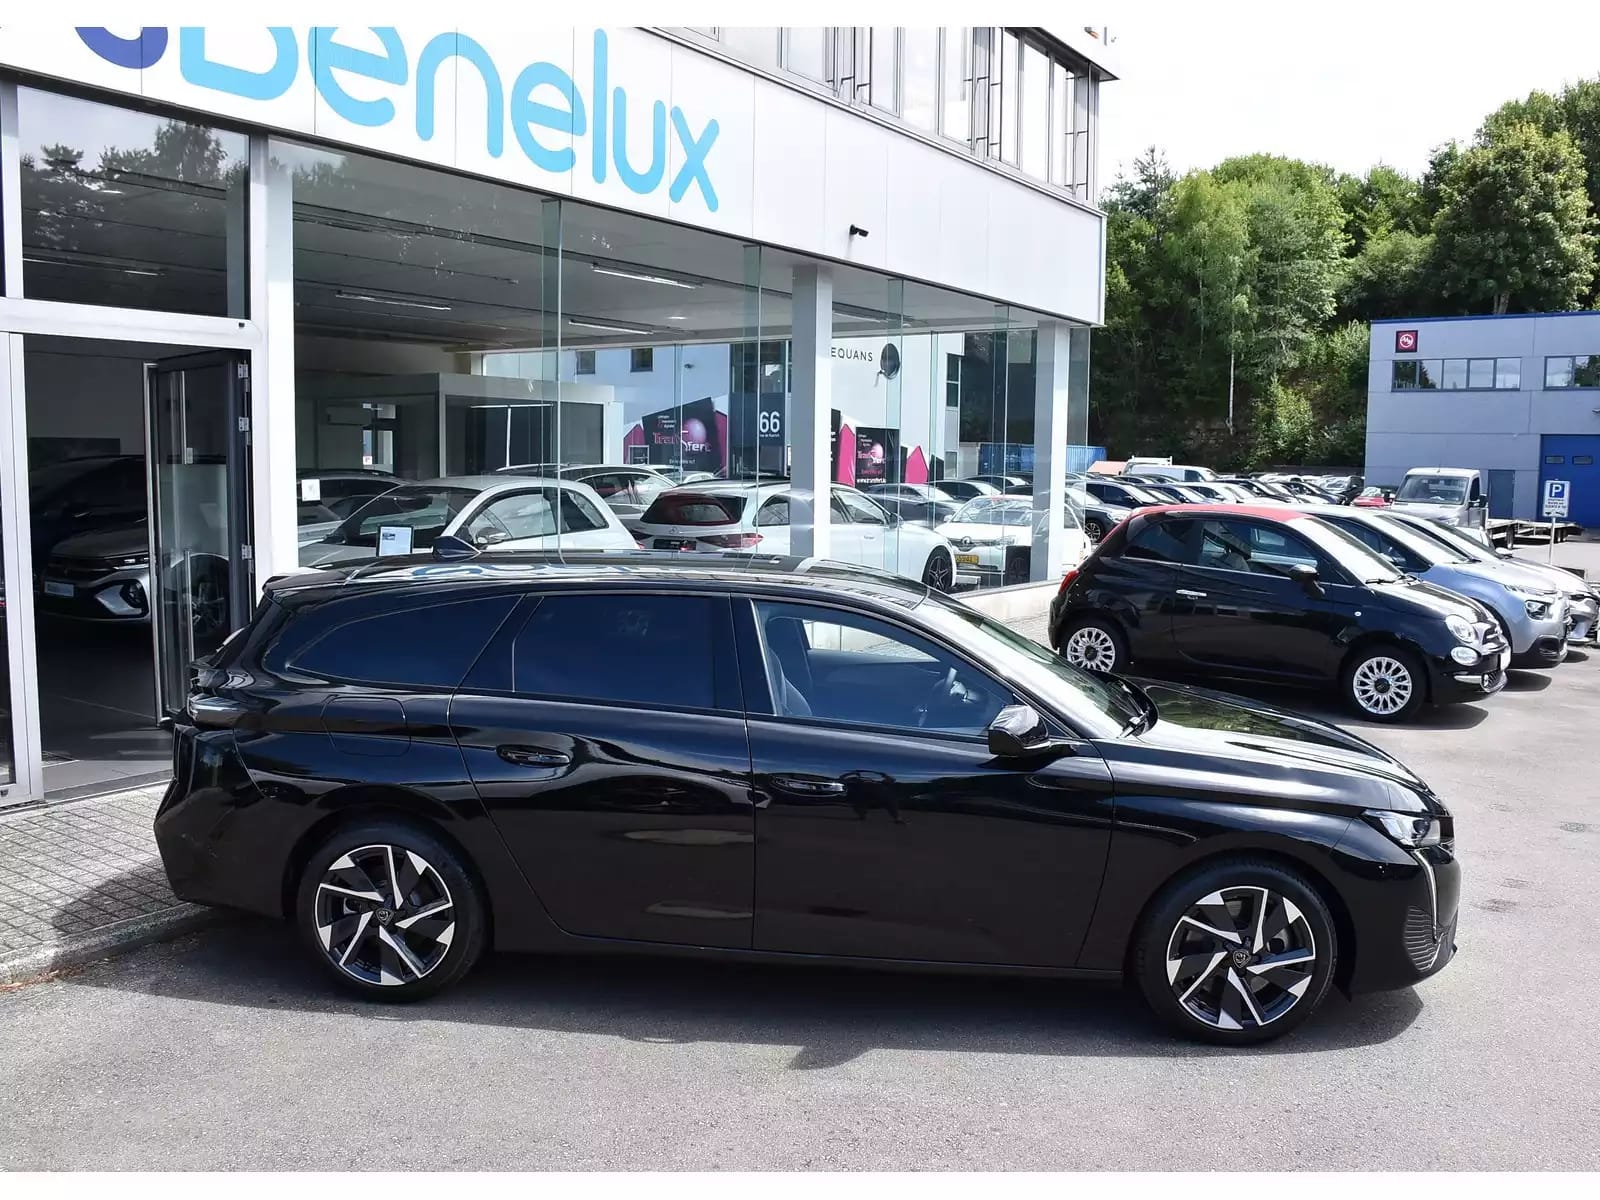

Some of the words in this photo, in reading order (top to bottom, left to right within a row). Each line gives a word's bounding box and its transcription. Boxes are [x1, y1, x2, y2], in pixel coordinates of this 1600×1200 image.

[831, 347, 873, 362] EQUANS
[760, 411, 780, 433] 66
[1552, 484, 1562, 497] P
